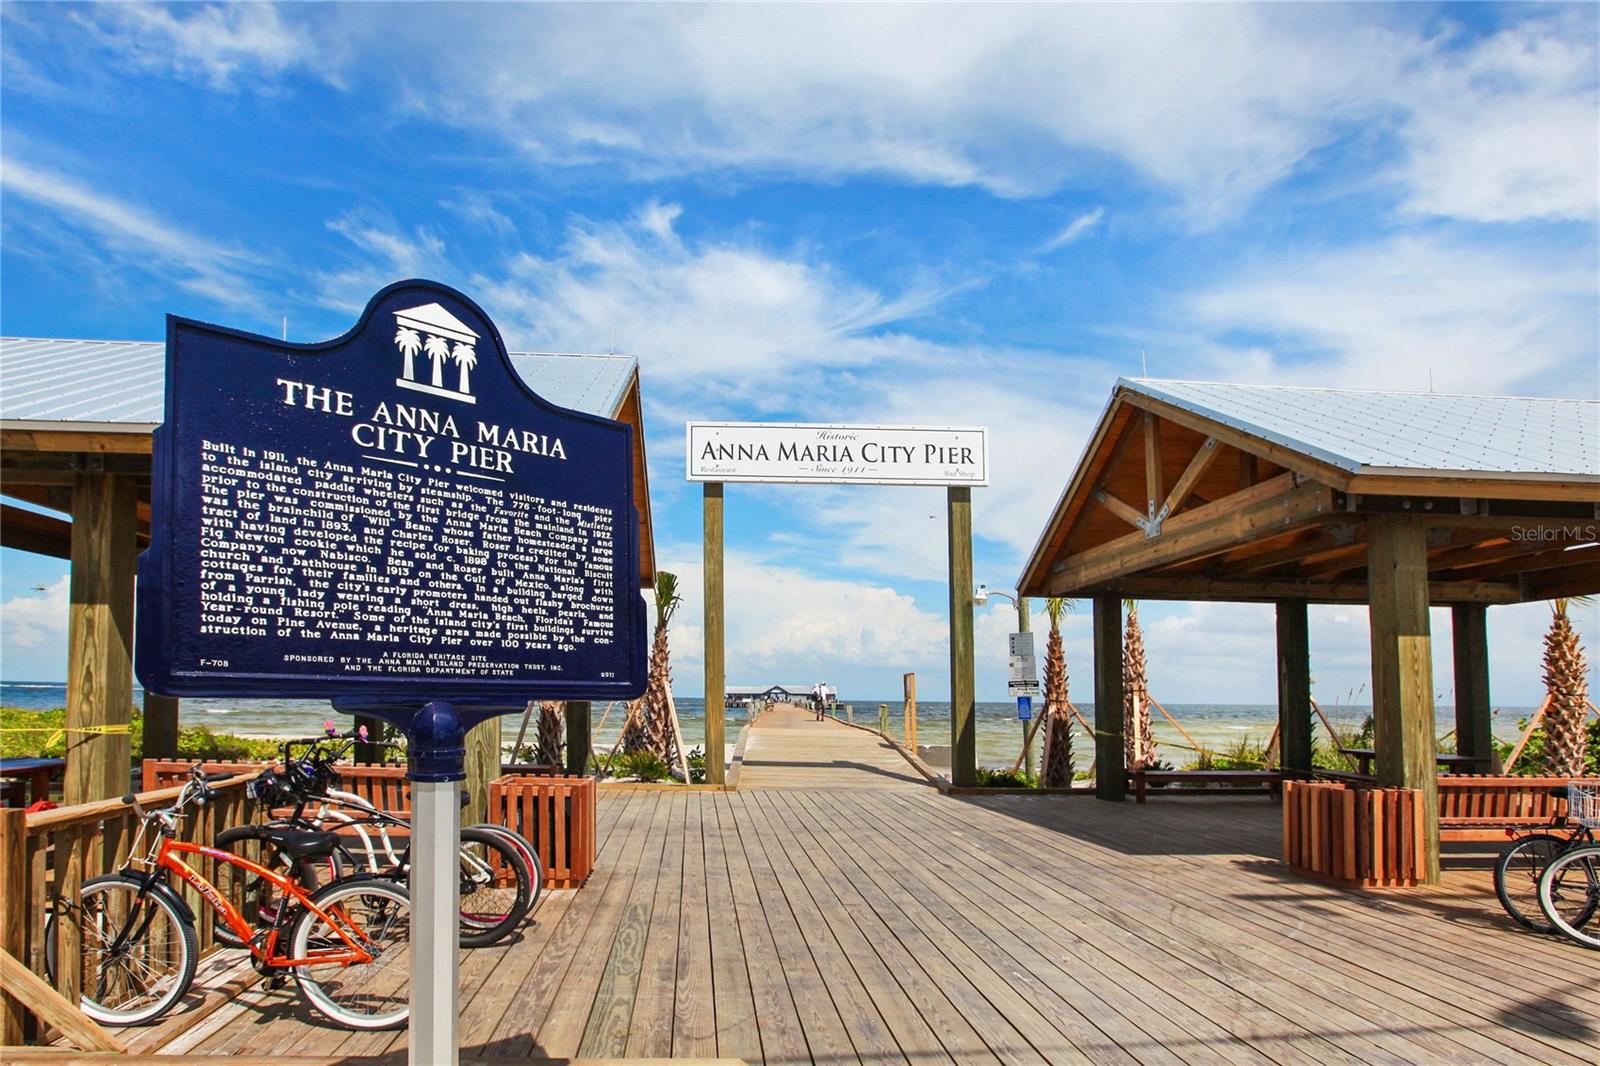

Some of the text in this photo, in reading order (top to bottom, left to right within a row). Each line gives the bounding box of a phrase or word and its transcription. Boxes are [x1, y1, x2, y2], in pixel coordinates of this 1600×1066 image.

[277, 378, 567, 460] THE ANNA MARIA
[352, 423, 514, 473] CITY PIER
[816, 430, 859, 441] Historic
[701, 440, 975, 464] ANNA MARIA CITY PIER
[202, 440, 235, 454] Built
[243, 447, 256, 457] in
[296, 456, 317, 467] the
[323, 461, 353, 473] Anna
[361, 466, 393, 480] Maria
[397, 473, 422, 485] City
[428, 477, 449, 488] Pier
[455, 484, 503, 497] welcomed
[509, 492, 544, 504] visitors
[550, 500, 567, 508] and
[573, 503, 612, 515] residents
[811, 464, 865, 475] Since 1911
[958, 470, 975, 479] Shop
[201, 451, 216, 461] to
[226, 456, 249, 467] the
[259, 460, 298, 474] island
[307, 469, 333, 480] city
[342, 475, 392, 491] arriving
[399, 482, 413, 493] by
[420, 487, 474, 502] steamship.
[485, 496, 504, 506] The
[594, 514, 612, 523] pier
[201, 483, 228, 495] The
[236, 489, 265, 501] pier
[273, 495, 298, 505] was
[310, 500, 390, 517] commissioned
[398, 510, 412, 522] by
[421, 514, 439, 523] the
[445, 517, 471, 528] Anna
[479, 521, 508, 533] Maria
[514, 526, 541, 538] Beach
[548, 531, 588, 545] Company
[202, 505, 238, 518] tract
[246, 511, 261, 520] of
[270, 513, 297, 525] land
[303, 517, 315, 527] in
[321, 520, 351, 532] 1893,
[363, 527, 384, 536] and
[391, 529, 433, 541] Charles
[441, 535, 472, 546] Roser.
[482, 540, 510, 551] Roser
[516, 544, 524, 553] is
[528, 547, 567, 558] credited
[575, 552, 586, 561] by
[200, 537, 613, 587] Company, now Nabisco. Bean and Roser built Anna Maria's first
[200, 570, 613, 611] from Parrish, the city's early promoters handed out flashy brochures
[201, 559, 263, 575] cottages
[273, 565, 294, 575] for
[302, 568, 334, 578] their
[343, 571, 390, 583] families
[399, 578, 420, 586] and
[428, 580, 464, 590] others.
[475, 583, 486, 592] In
[506, 586, 545, 599] building
[551, 590, 583, 601] barged
[591, 595, 613, 603] down
[200, 613, 242, 627] today
[251, 617, 267, 625] on
[277, 617, 305, 627] Pine
[315, 620, 362, 631] Avenue,
[389, 623, 438, 636] heritage
[445, 628, 469, 636] area
[475, 630, 501, 638] made
[507, 632, 547, 640] possible
[552, 633, 565, 642] by
[200, 624, 266, 636] struction
[277, 628, 291, 637] of
[300, 629, 321, 638] the
[329, 630, 359, 640] Anna
[366, 632, 399, 642] Maria
[409, 634, 433, 645] City
[441, 636, 462, 645] Pier
[501, 639, 519, 647] 100
[525, 641, 551, 649] years
[557, 643, 576, 651] ago.
[353, 611, 385, 622] Some
[393, 614, 406, 623] of
[411, 615, 429, 624] the
[435, 617, 466, 627] island
[471, 620, 500, 629] city's
[506, 622, 528, 630] first
[533, 623, 574, 634] buildings
[581, 626, 613, 635] survive
[283, 654, 334, 662] SPONSORED
[468, 661, 519, 669] PRESERVATION
[388, 665, 420, 673] FLORIDA
[392, 651, 424, 659] FLORIDA
